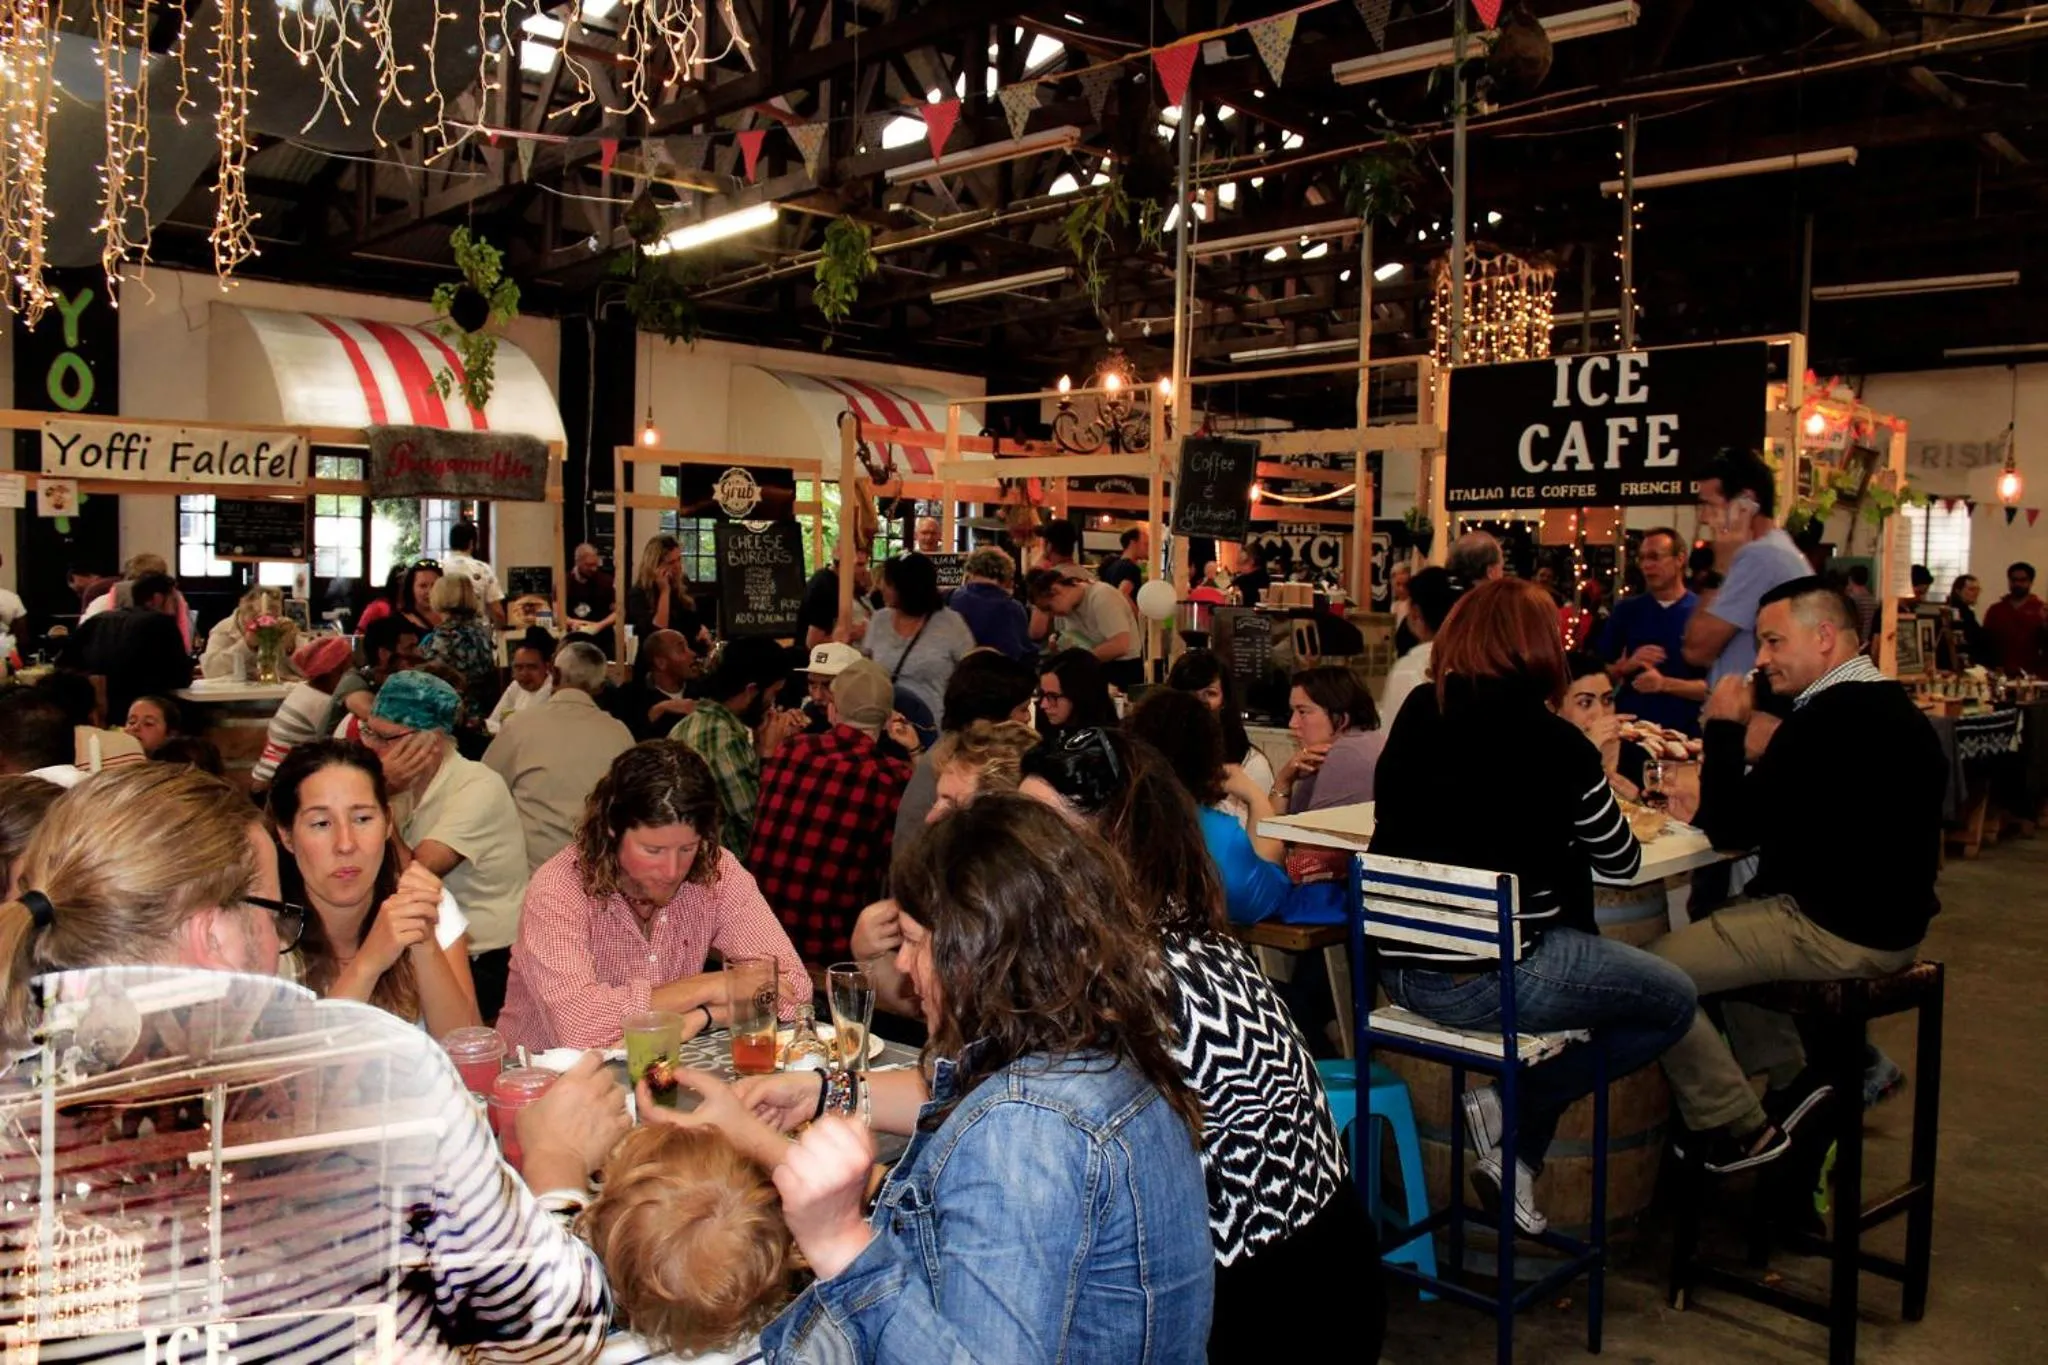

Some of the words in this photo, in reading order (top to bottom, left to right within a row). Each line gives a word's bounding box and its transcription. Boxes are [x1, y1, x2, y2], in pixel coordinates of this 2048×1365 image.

[1552, 352, 1649, 407] ICE
[47, 432, 152, 470] Yoffi
[169, 440, 299, 479] Falafel
[1518, 414, 1679, 473] CAFE
[1191, 451, 1236, 480] Coffee
[720, 480, 755, 502] Grub
[1510, 485, 1535, 498] ICE
[1541, 484, 1597, 498] COFFEE
[1620, 481, 1682, 496] FRENCH
[1690, 481, 1702, 494] D
[728, 534, 784, 551] CHEESE
[1282, 525, 1315, 535] THE
[727, 551, 792, 567] BURGERS
[142, 1323, 238, 1365] ICE
